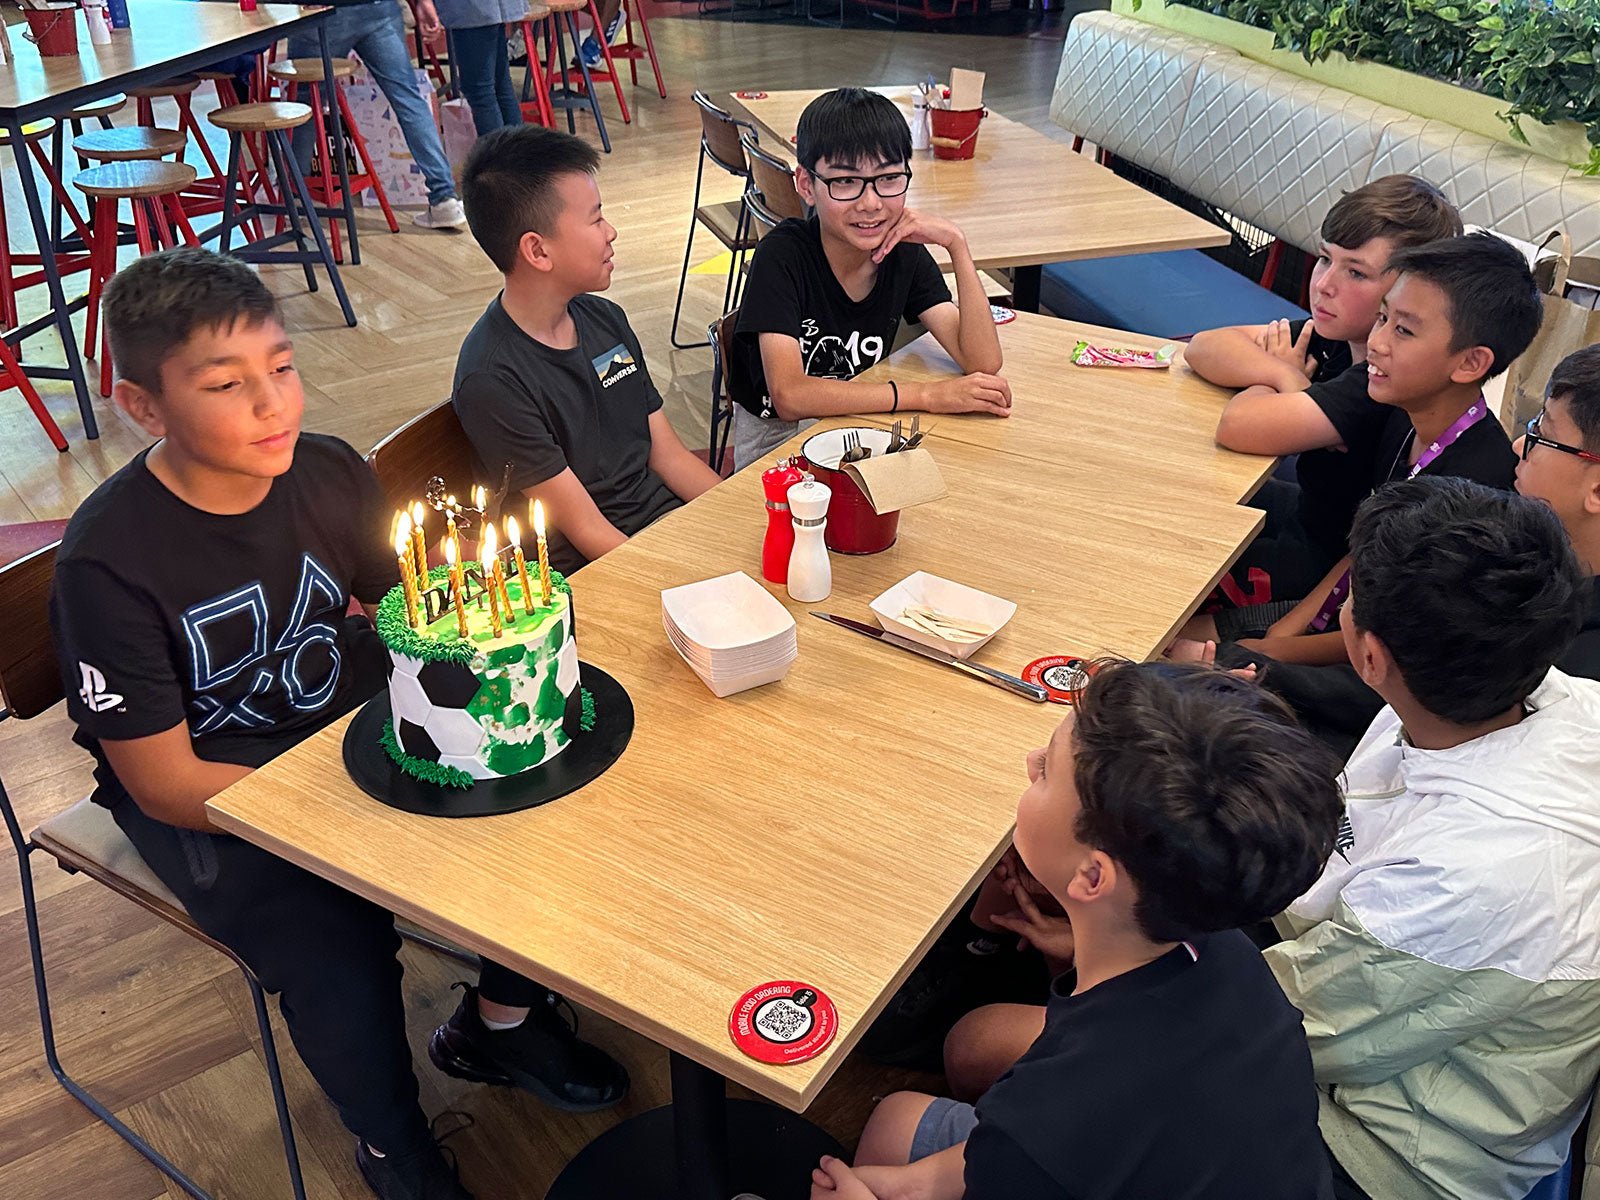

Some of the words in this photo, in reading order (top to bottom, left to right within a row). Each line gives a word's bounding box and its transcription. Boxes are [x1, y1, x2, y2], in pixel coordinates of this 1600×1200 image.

[602, 363, 638, 388] CONVERSE
[754, 986, 791, 1000] ORDERING
[741, 997, 757, 1013] FOOD
[738, 1013, 750, 1036] MOBILE
[784, 1041, 813, 1054] Delivered
